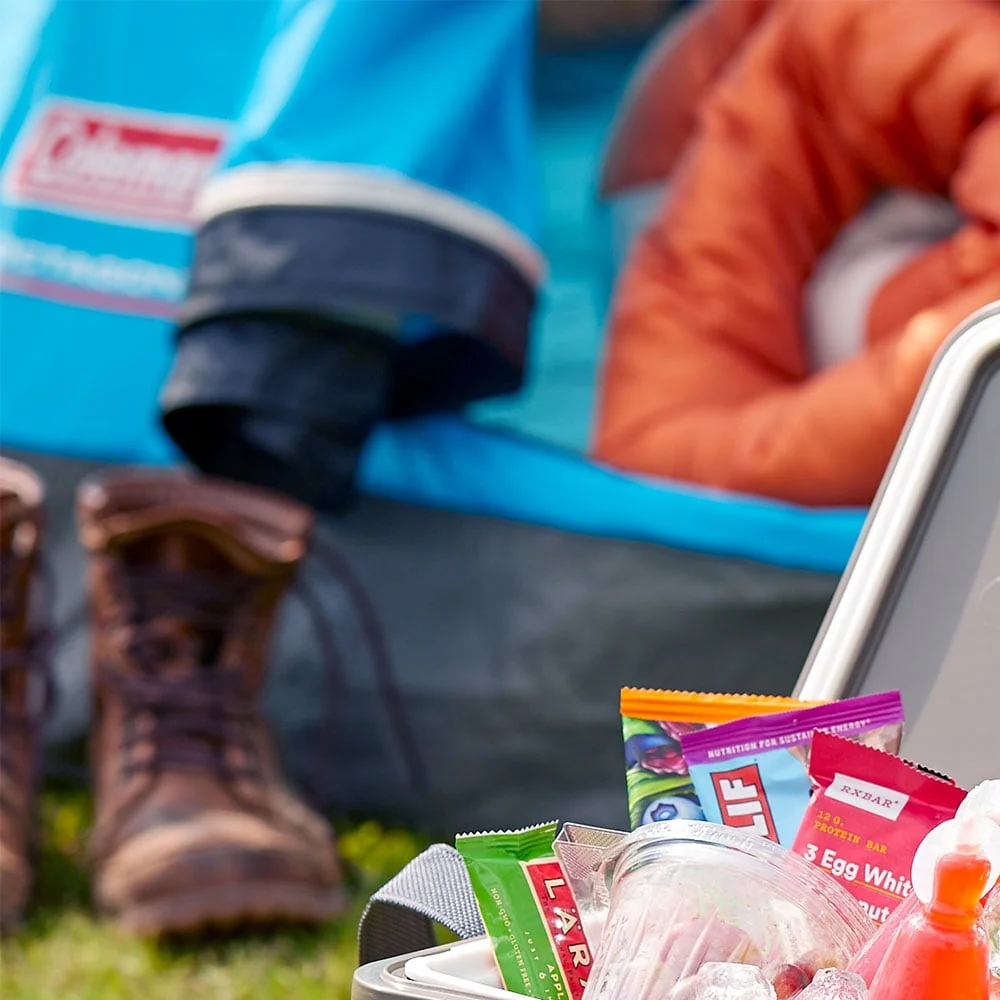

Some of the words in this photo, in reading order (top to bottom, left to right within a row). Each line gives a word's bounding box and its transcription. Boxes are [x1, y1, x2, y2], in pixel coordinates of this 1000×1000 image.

[708, 741, 758, 759] NUTRITION
[759, 737, 777, 749] FOR
[719, 777, 769, 837] LIF
[841, 785, 894, 809] RXBAR
[818, 810, 831, 821] 12
[814, 820, 860, 844] PROTEIN
[865, 840, 888, 854] BAR
[804, 843, 818, 862] 3
[820, 848, 859, 881] Egg
[864, 863, 912, 898] Whit
[525, 930, 540, 961] JUST
[510, 934, 525, 967] GLUTEN
[520, 968, 531, 991] FREE
